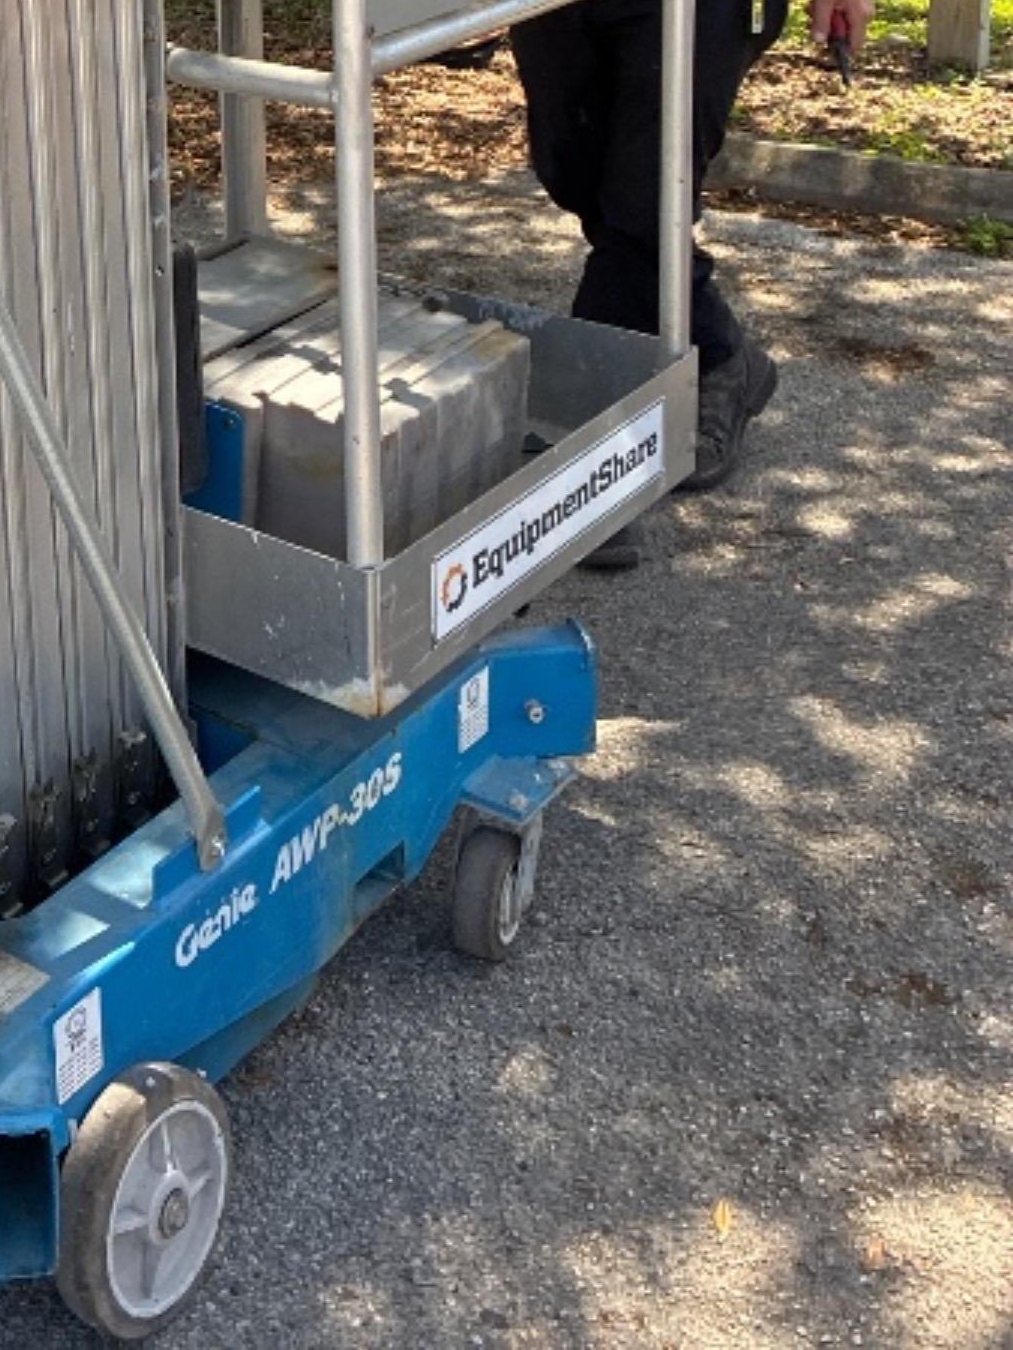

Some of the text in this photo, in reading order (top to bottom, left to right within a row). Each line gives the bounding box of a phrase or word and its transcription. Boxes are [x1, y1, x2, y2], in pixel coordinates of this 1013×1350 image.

[472, 432, 657, 588] EquipmentShare
[175, 752, 403, 968] Genie AWP-30S
